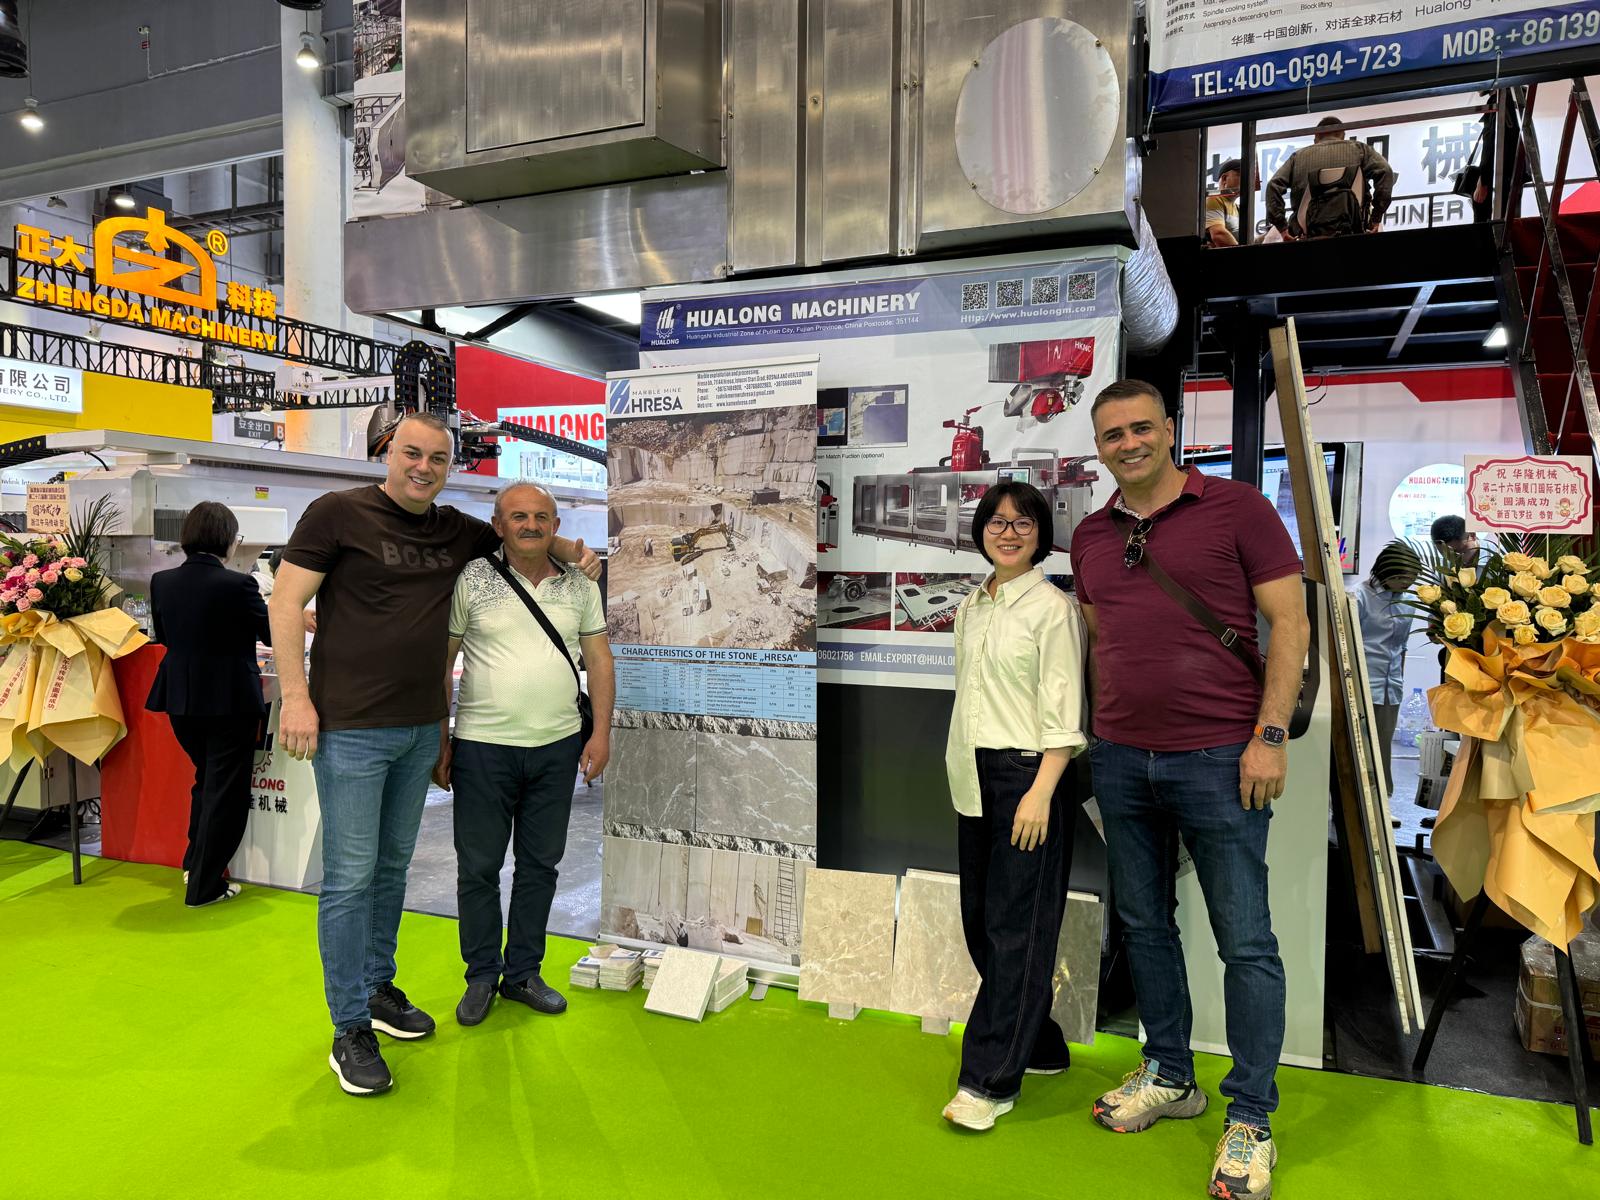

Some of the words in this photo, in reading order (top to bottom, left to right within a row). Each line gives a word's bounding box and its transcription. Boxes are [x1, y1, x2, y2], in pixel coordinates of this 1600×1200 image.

[1270, 8, 1283, 16] form
[1192, 42, 1402, 98] TEL:400-0594-723
[16, 223, 87, 273] 正大
[226, 281, 277, 321] 科技
[17, 276, 145, 324] ZHENGDA
[151, 306, 277, 352] MACHINERY
[686, 304, 782, 328] HUALONG
[791, 292, 920, 320] MACHINERY
[686, 333, 712, 342] Huangshi
[713, 331, 739, 339] Industrial
[740, 330, 754, 338] Zone
[845, 321, 862, 330] China
[651, 338, 680, 347] HUALONG
[0, 386, 24, 397] ERY
[632, 388, 661, 396] MARBLE
[663, 386, 682, 394] MINE
[631, 396, 683, 413] HRESA
[238, 419, 271, 432] 安全出口
[248, 430, 261, 439] EXIT
[1513, 469, 1558, 479] 华隆机械
[621, 647, 693, 659] CHARACTERISTICS
[695, 650, 707, 659] OF
[709, 650, 726, 660] THE
[728, 651, 758, 661] STONE
[817, 649, 854, 661] 06021758
[251, 777, 285, 791] LONG
[250, 794, 288, 814] 机械
